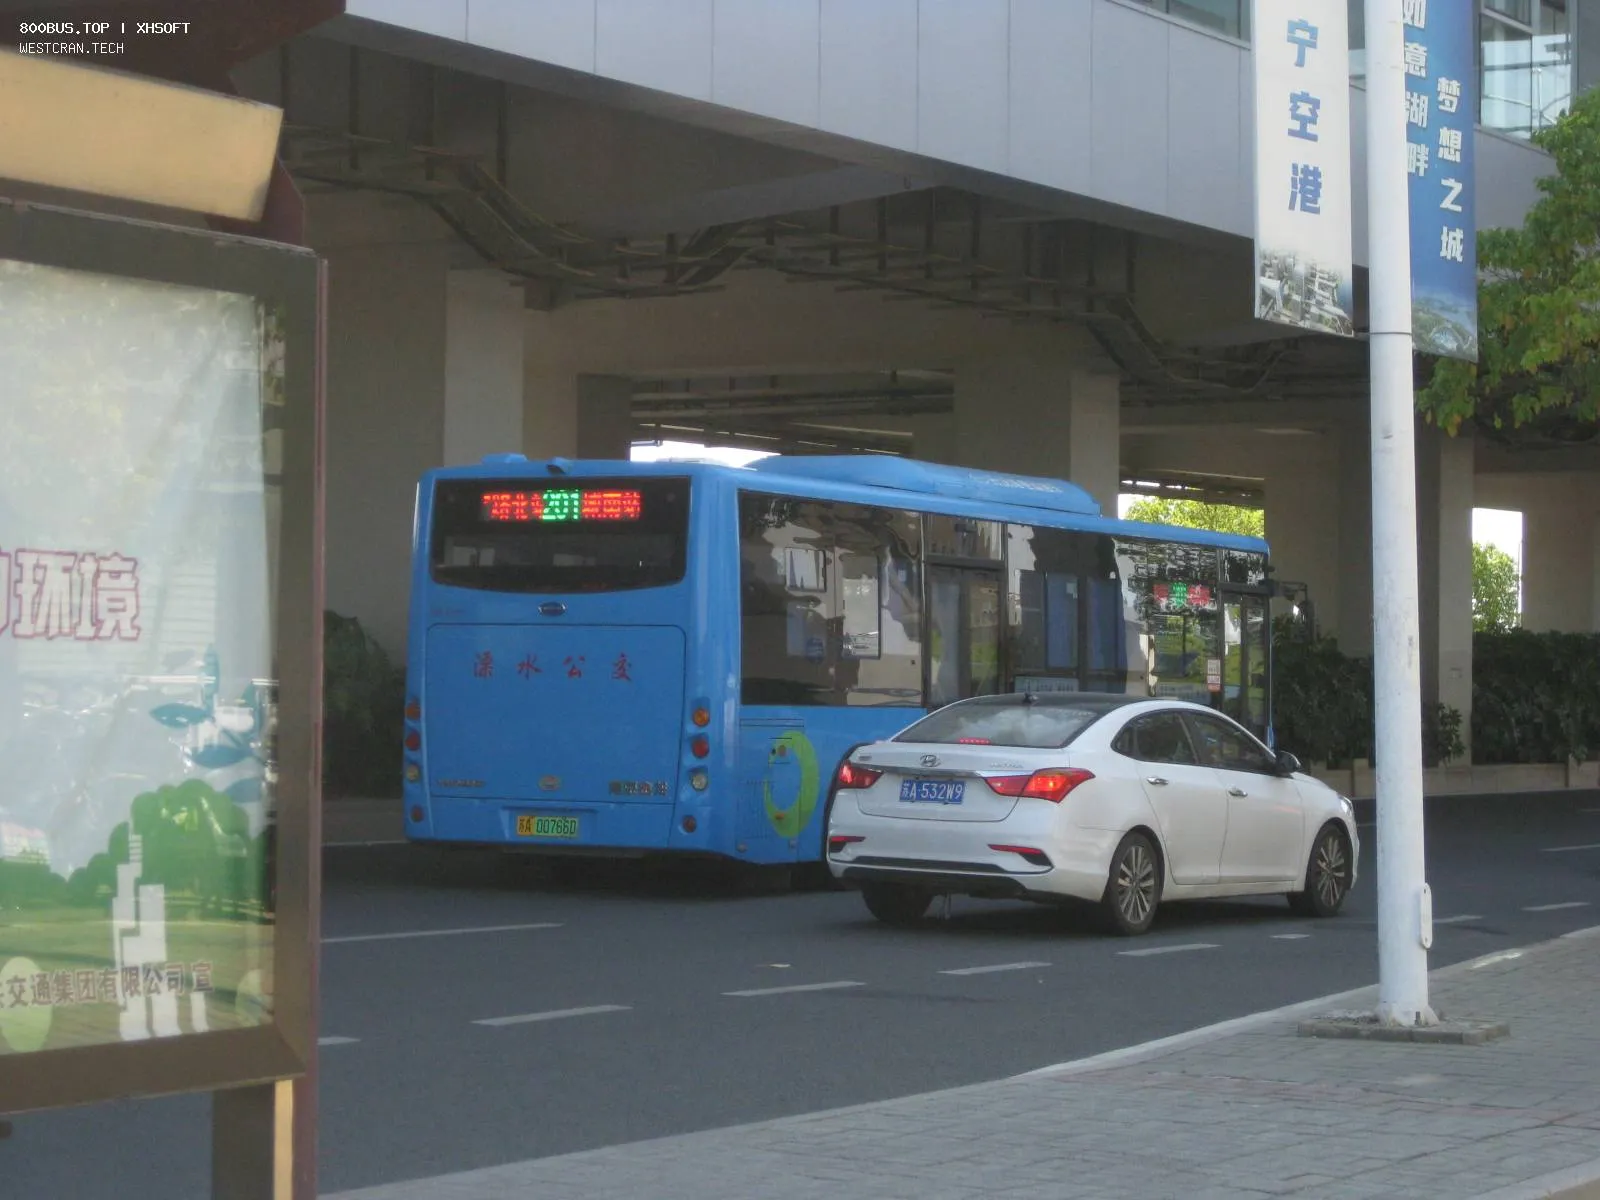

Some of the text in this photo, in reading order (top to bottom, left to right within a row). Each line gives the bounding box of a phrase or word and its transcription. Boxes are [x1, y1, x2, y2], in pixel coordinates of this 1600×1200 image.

[1286, 18, 1322, 215] 宁空港
[1437, 76, 1464, 263] 梦想之城
[0, 964, 185, 1008] 交通集团有限公司
